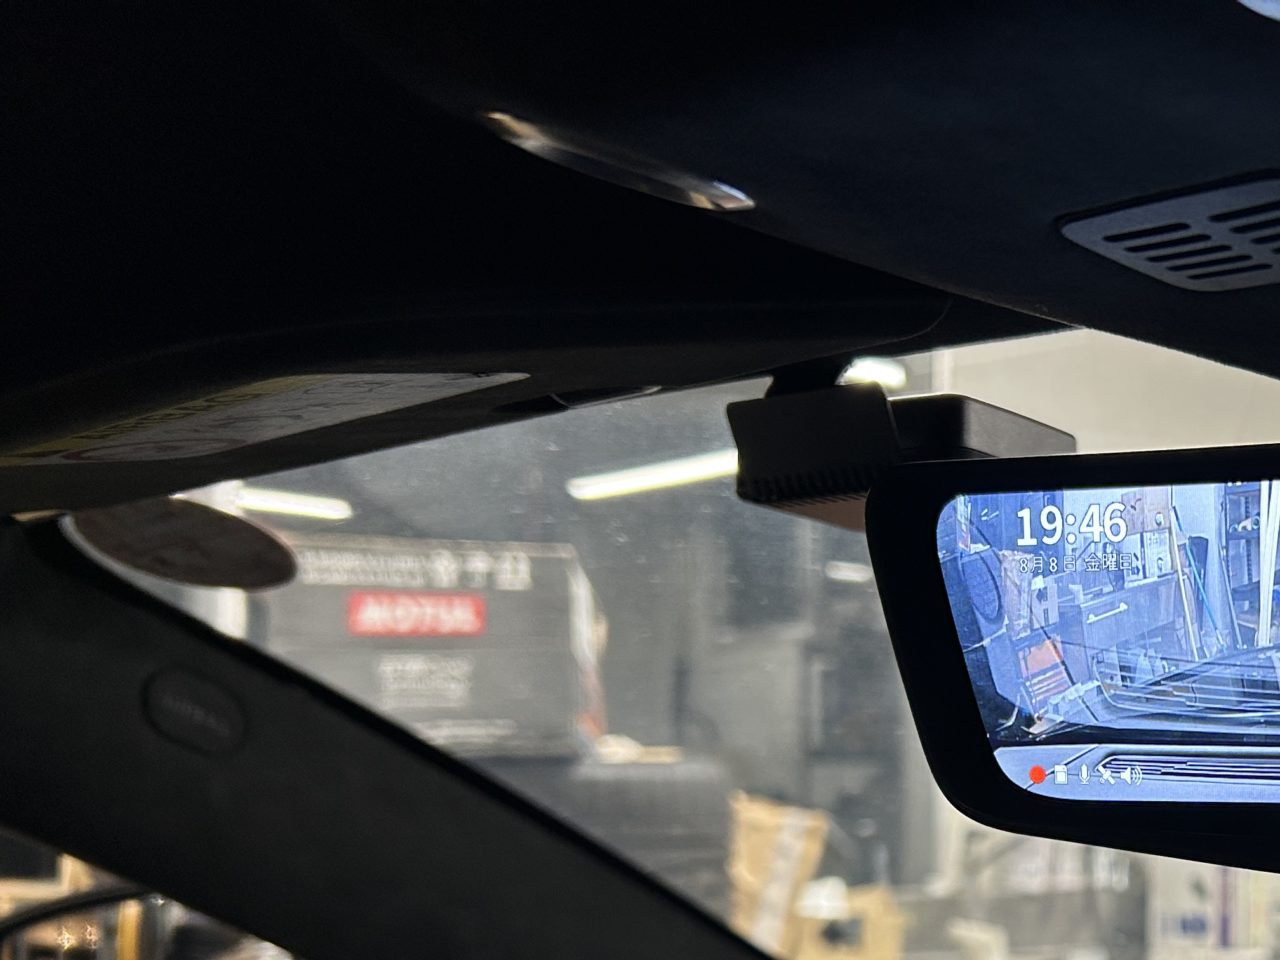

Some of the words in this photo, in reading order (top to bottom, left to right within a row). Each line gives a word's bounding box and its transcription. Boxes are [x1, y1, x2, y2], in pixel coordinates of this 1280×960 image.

[1017, 502, 1128, 546] 19:46
[1019, 555, 1077, 573] 8月8日
[1084, 552, 1133, 572] 金曜日
